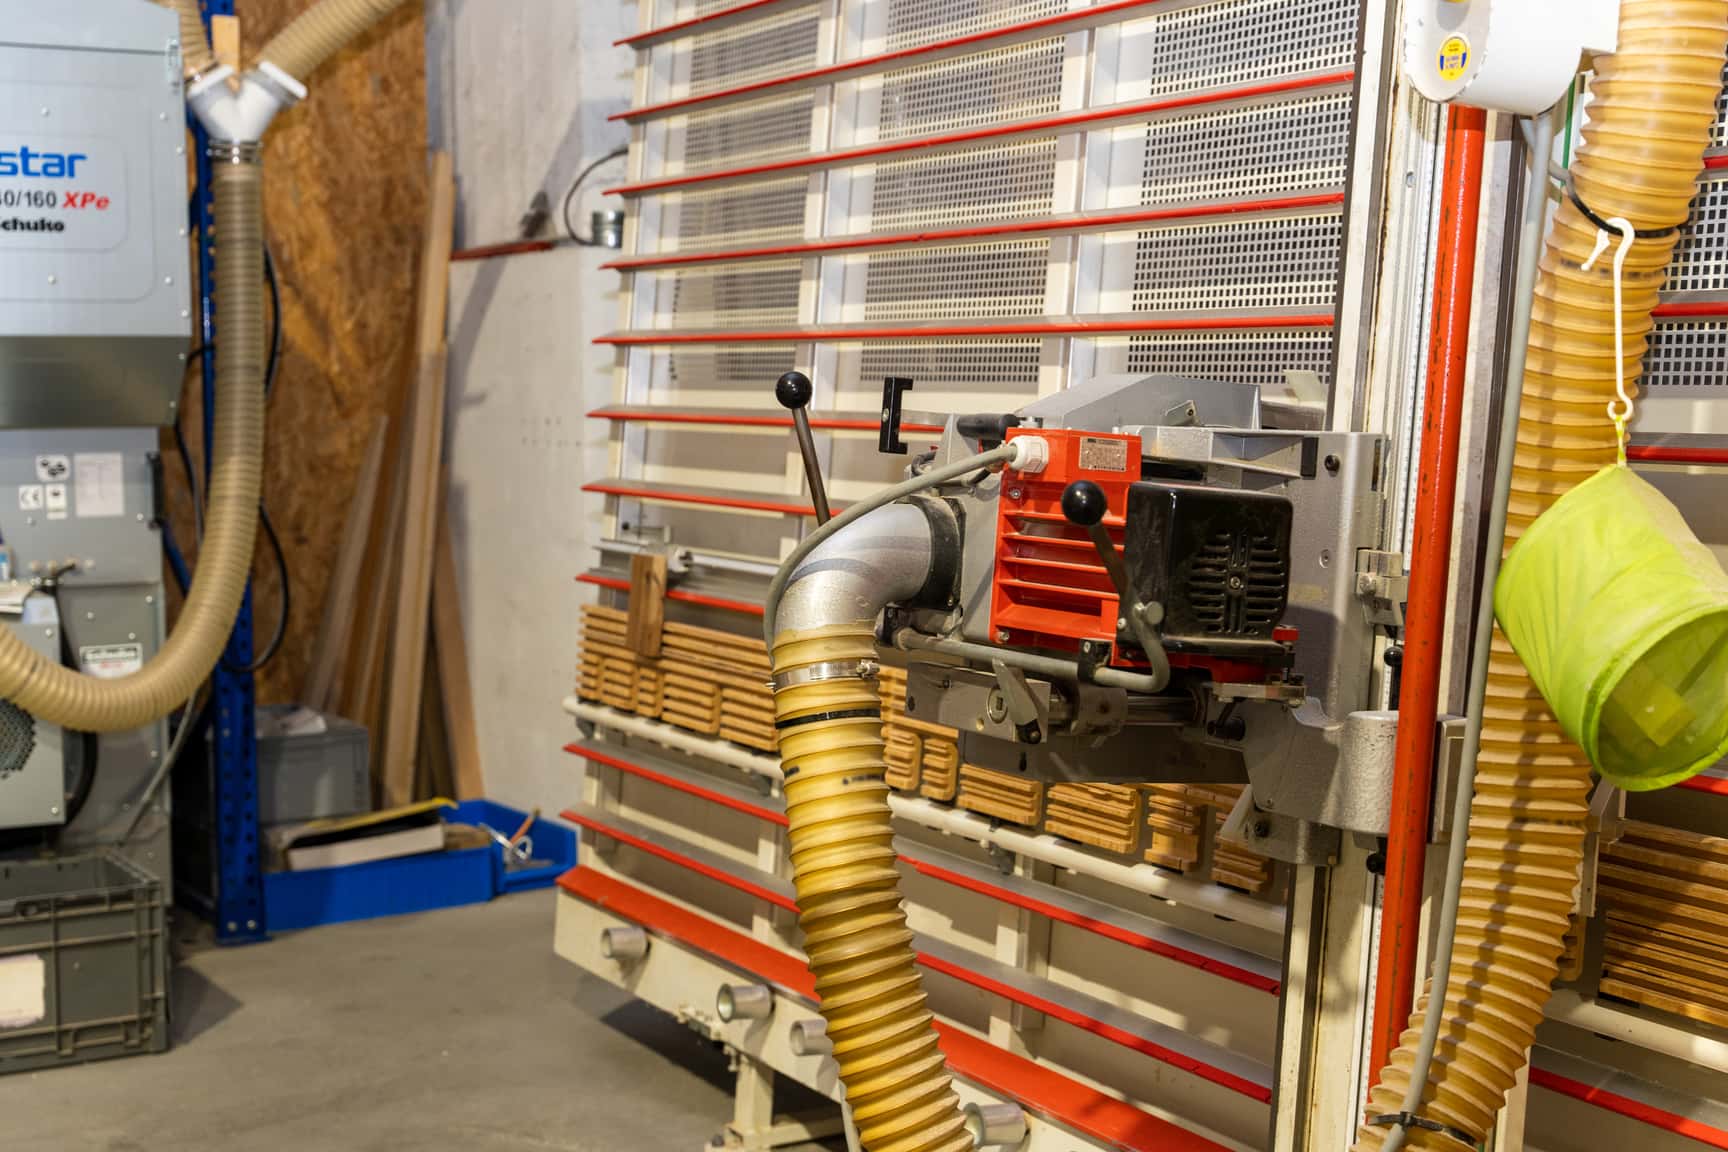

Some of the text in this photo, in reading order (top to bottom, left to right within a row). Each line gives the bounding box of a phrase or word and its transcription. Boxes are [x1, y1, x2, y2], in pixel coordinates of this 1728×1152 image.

[0, 146, 87, 178] star
[0, 190, 110, 210] 0/160 XPe
[0, 217, 65, 232] chuko
